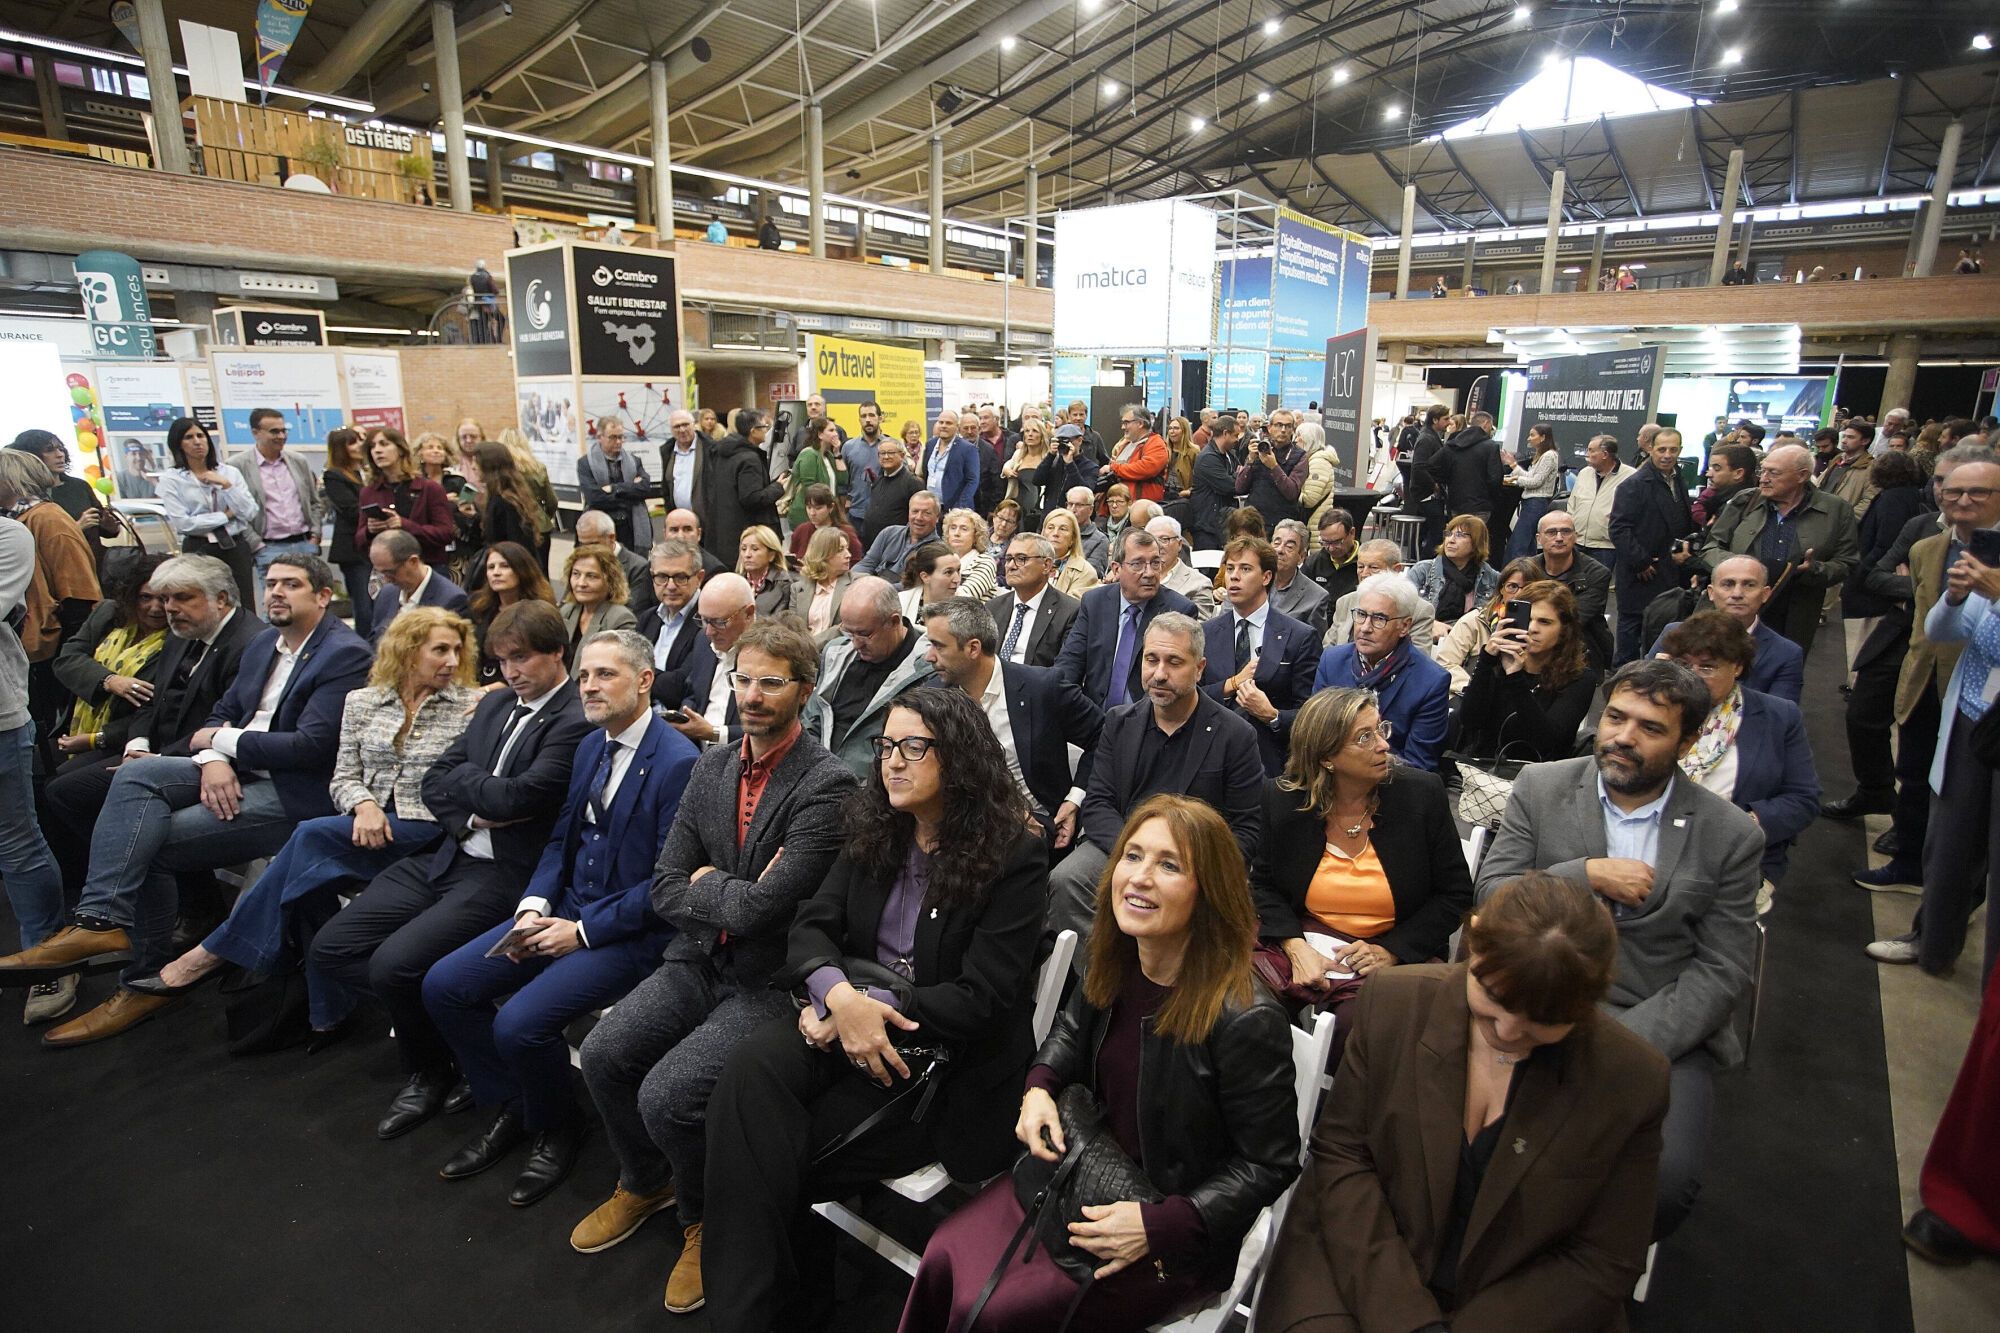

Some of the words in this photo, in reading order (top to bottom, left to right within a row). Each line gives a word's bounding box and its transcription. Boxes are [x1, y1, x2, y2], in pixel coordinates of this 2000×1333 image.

[614, 268, 658, 284] Cambra
[587, 295, 617, 307] SALUT
[618, 297, 622, 308] I
[623, 297, 667, 310] BENESTAR
[1248, 297, 1271, 307] diem
[273, 322, 308, 332] Cambra
[1235, 320, 1257, 330] diem
[840, 346, 876, 379] travel
[1525, 391, 1546, 409] GIRONA
[1545, 390, 1570, 409] MEREIX
[1569, 390, 1583, 409] UNA
[1583, 389, 1623, 410] MOBILITAT
[1621, 389, 1646, 411] NETA.
